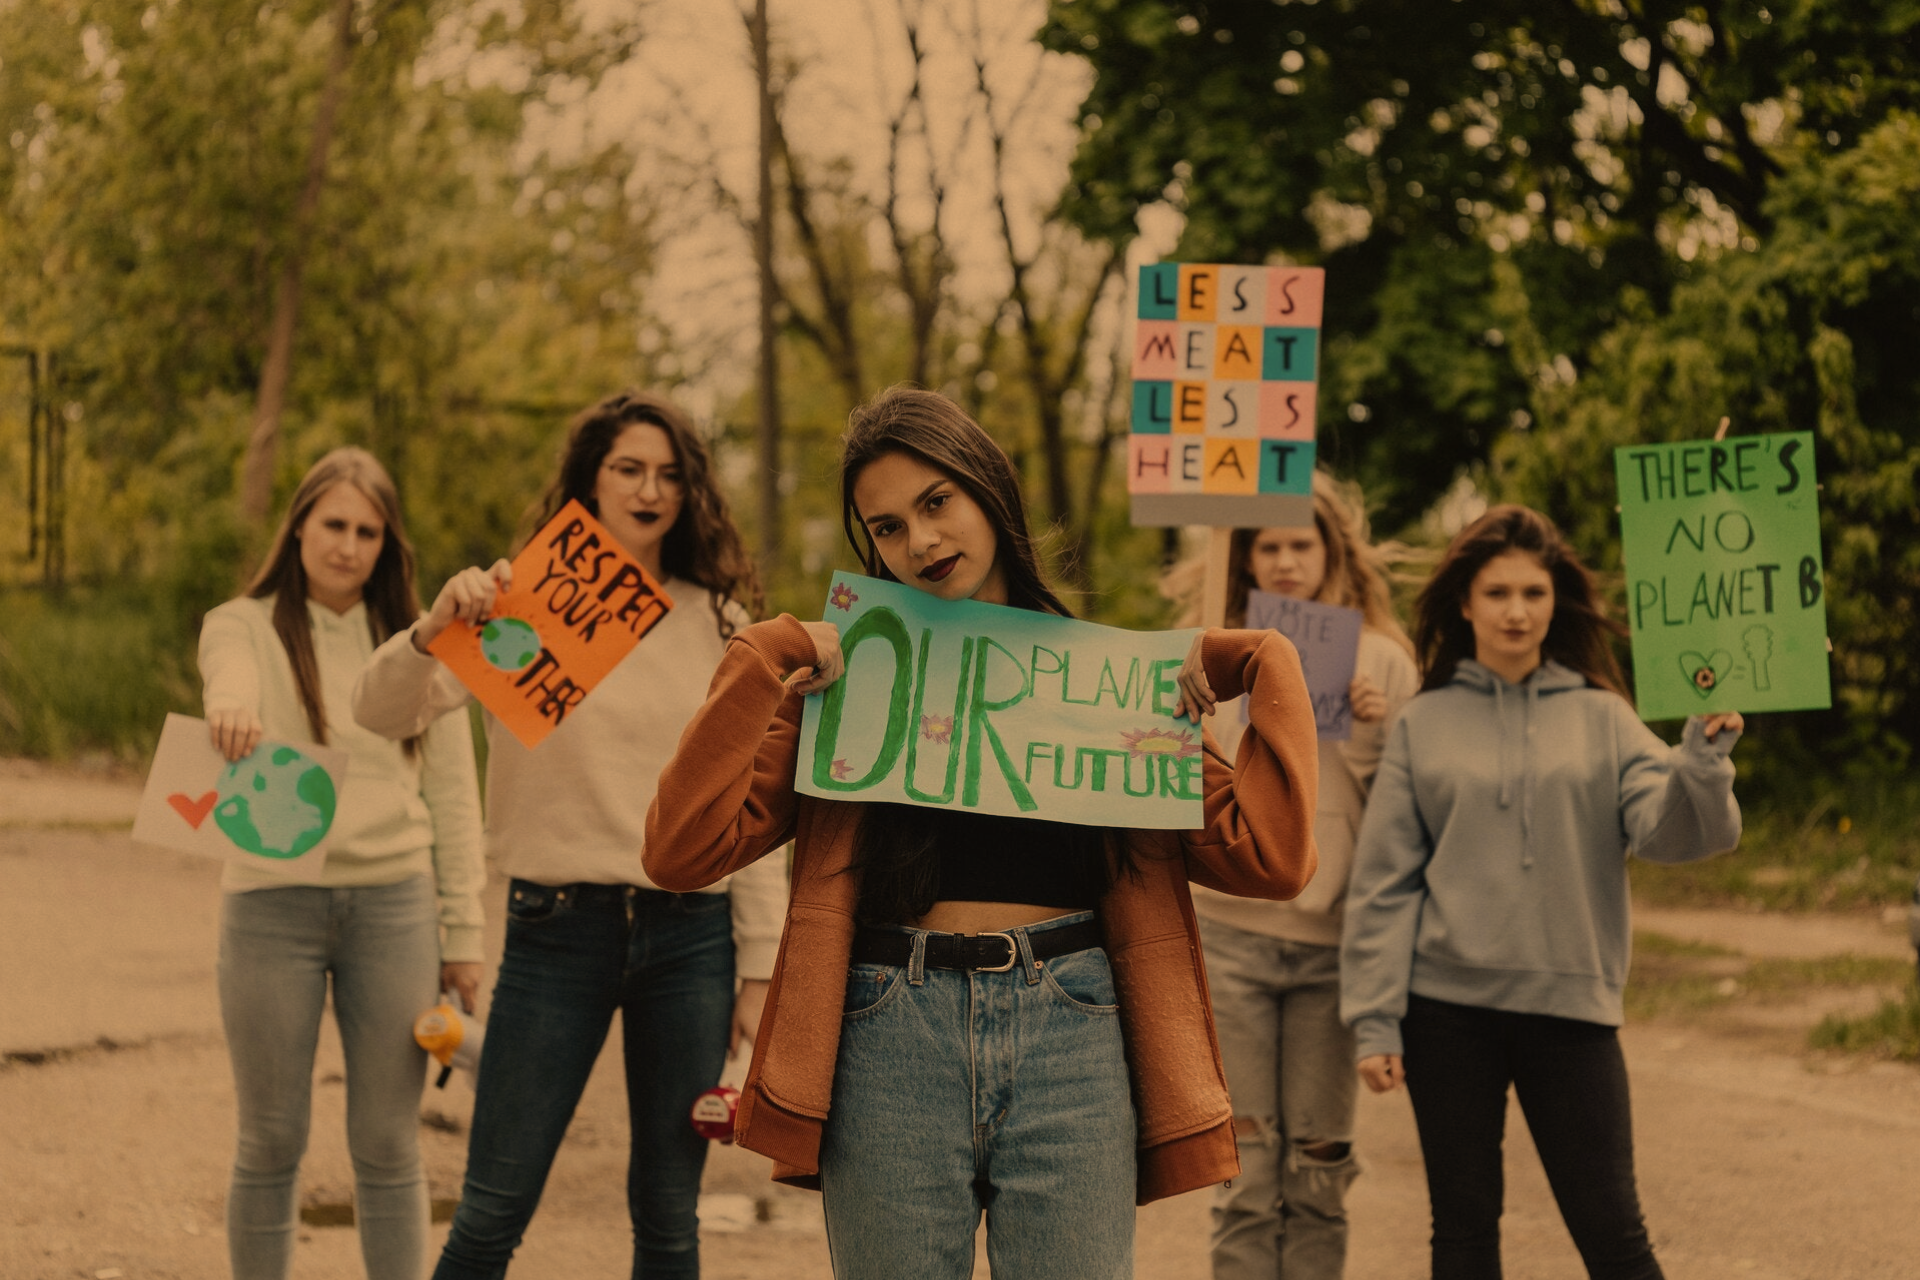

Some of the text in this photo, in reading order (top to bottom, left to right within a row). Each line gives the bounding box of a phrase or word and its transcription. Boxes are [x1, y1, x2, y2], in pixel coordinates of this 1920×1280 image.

[1155, 271, 1300, 314] LESS
[1141, 330, 1298, 371] MEAT
[1149, 385, 1300, 430] LESS
[1136, 444, 1297, 484] HEAT
[1629, 438, 1803, 503] THERE'S
[1665, 509, 1755, 555] NO
[533, 558, 613, 643] YOUR
[548, 518, 671, 641] RESPECT
[1636, 554, 1822, 630] PLANET B
[812, 605, 1038, 812] OUR
[1028, 643, 1185, 717] PLANE
[1024, 741, 1203, 801] FUTURE
